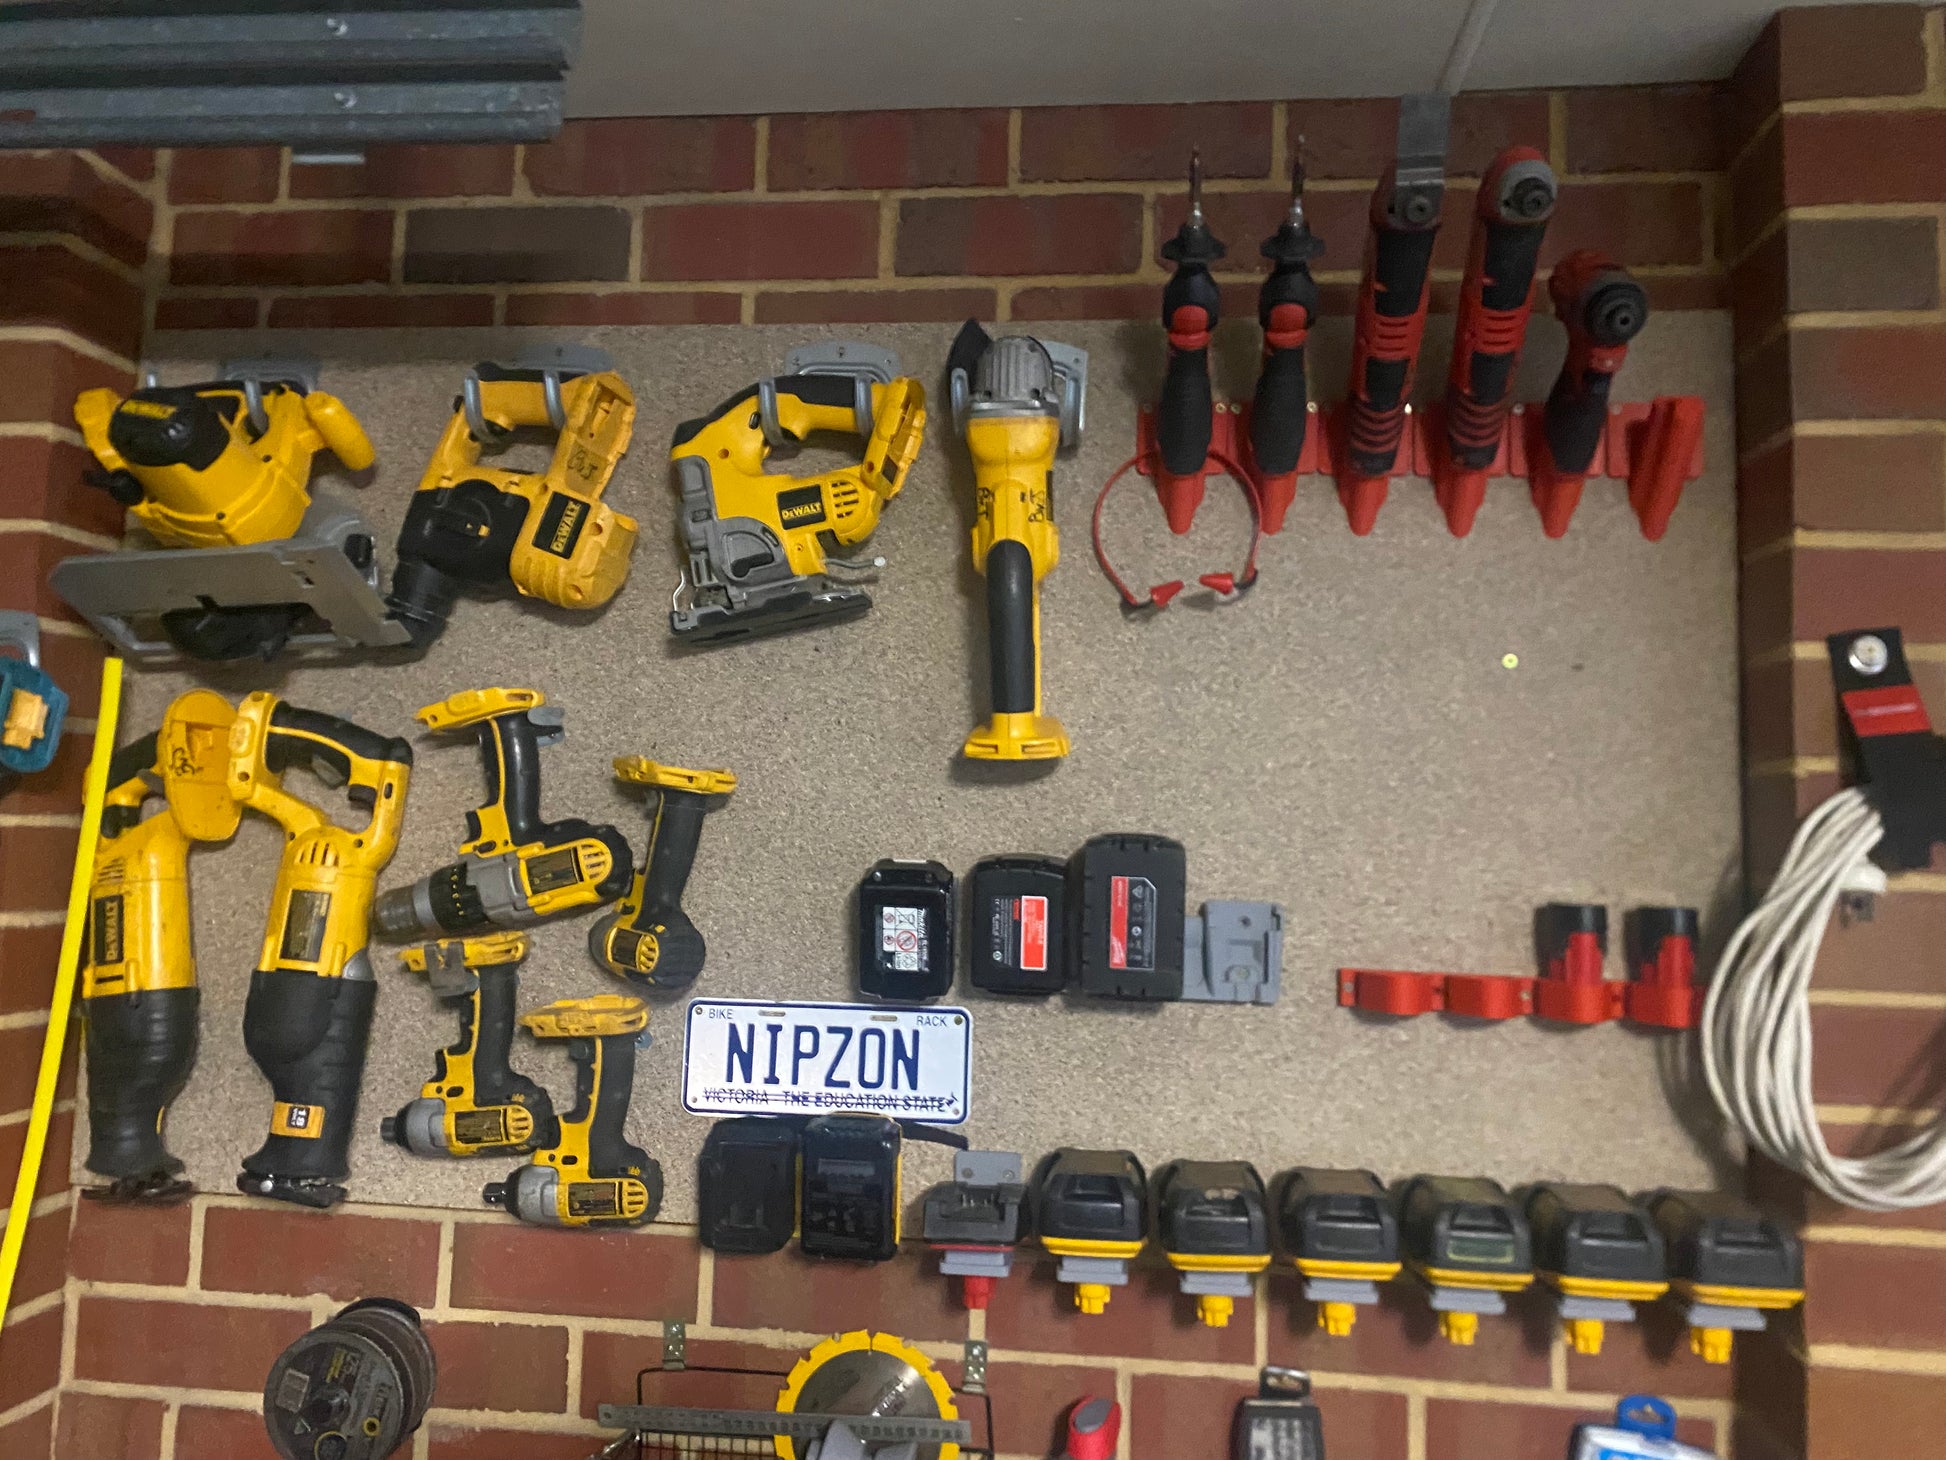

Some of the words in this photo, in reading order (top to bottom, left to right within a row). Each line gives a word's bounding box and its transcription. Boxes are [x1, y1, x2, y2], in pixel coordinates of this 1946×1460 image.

[708, 1008, 733, 1021] BIKE
[916, 1014, 947, 1027] RACK
[725, 1022, 920, 1091] NIPZON
[702, 1086, 769, 1105] VICTORIA
[782, 1090, 810, 1107] THE
[814, 1091, 898, 1110] EDUCATION
[903, 1095, 947, 1112] STATE
